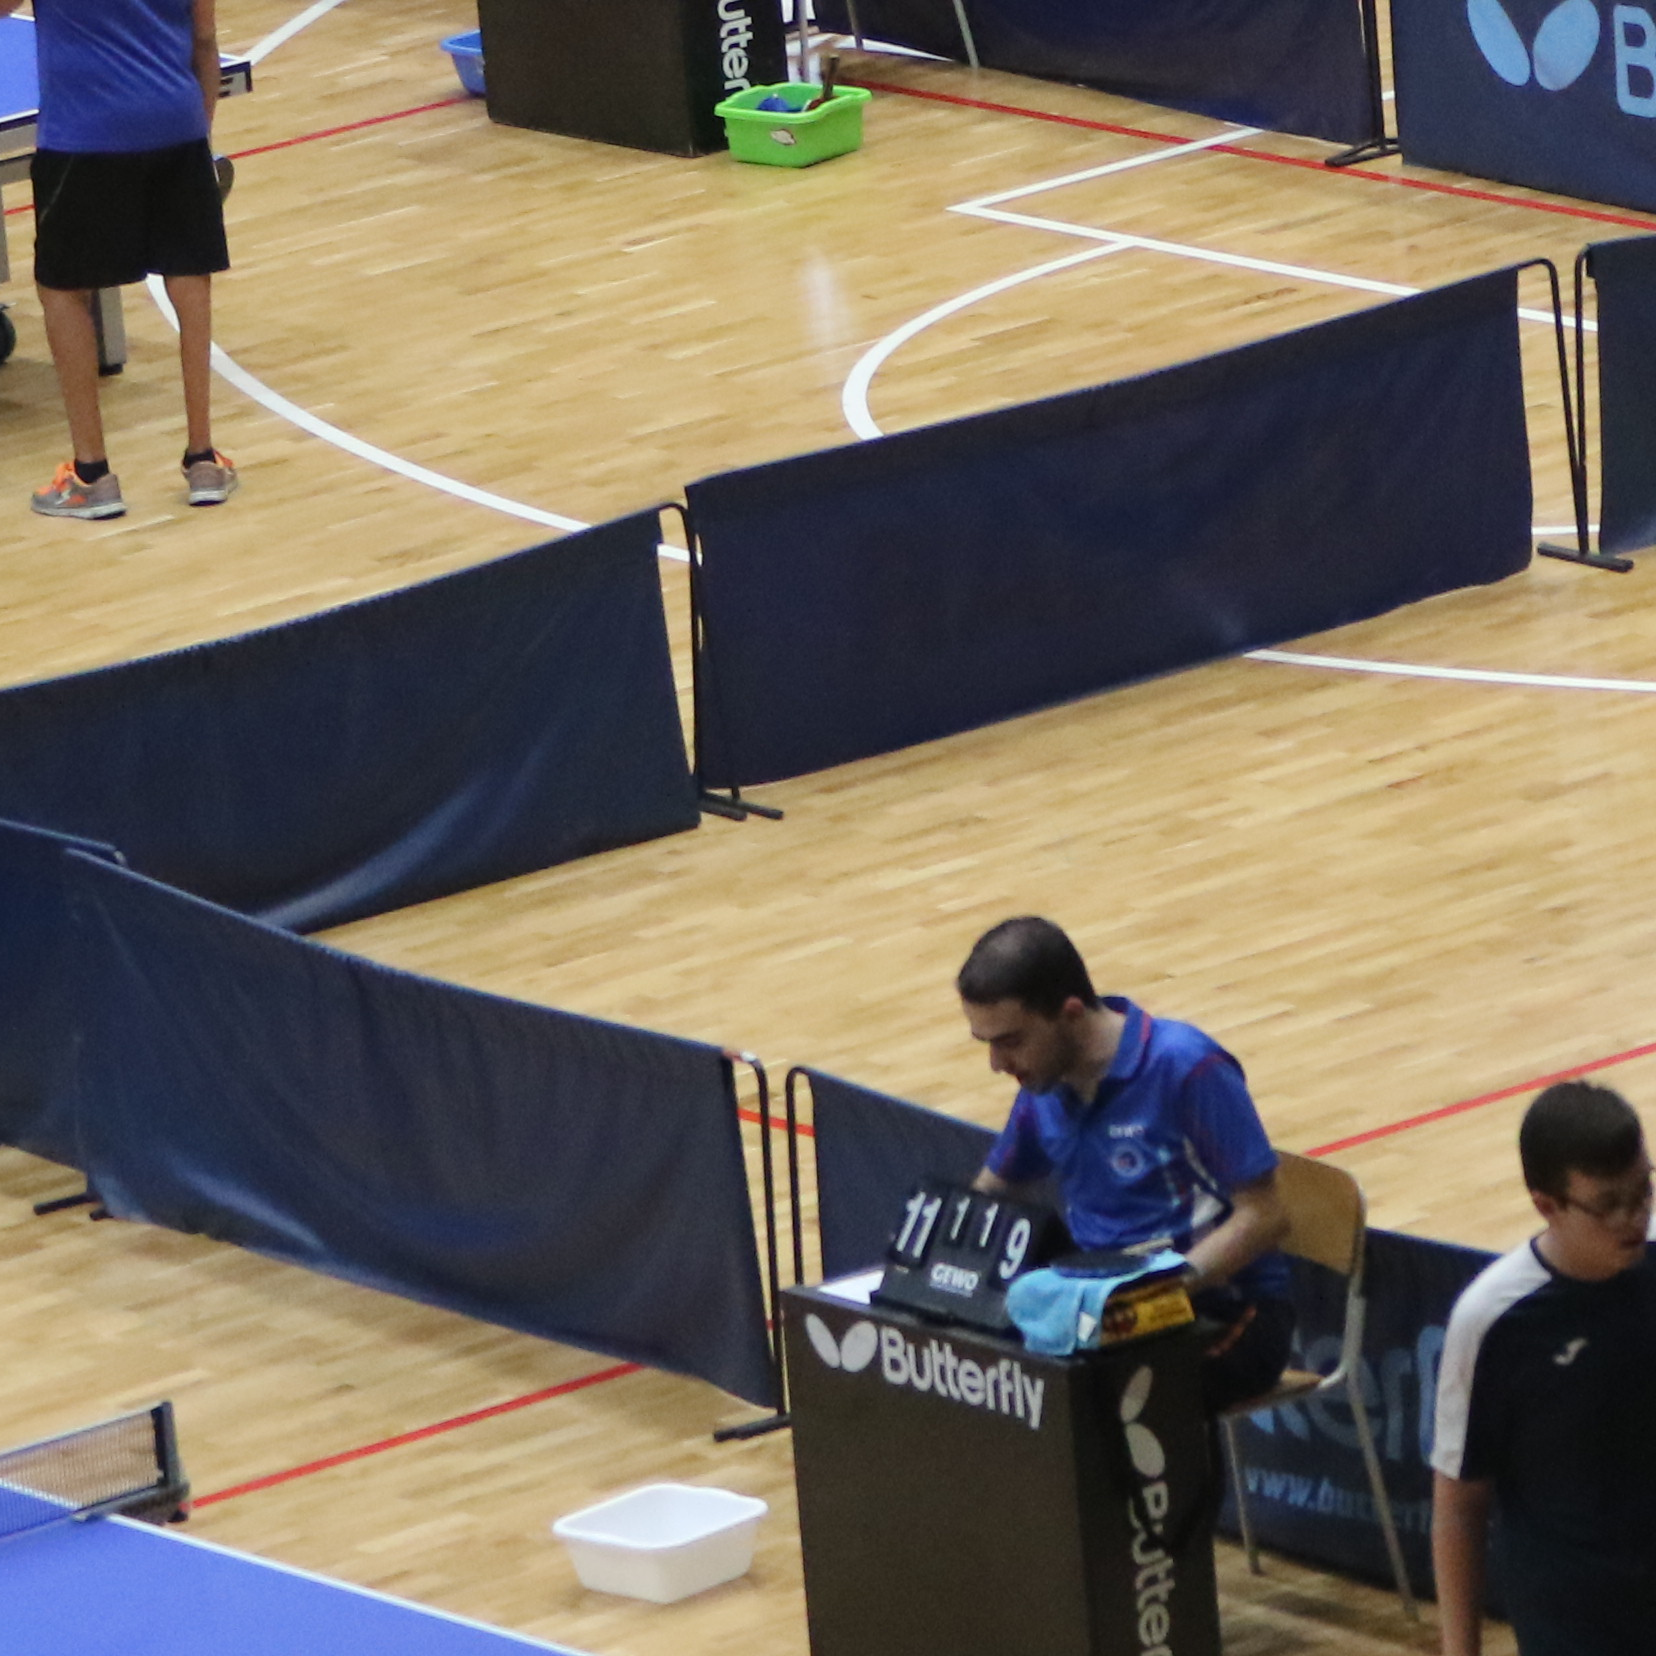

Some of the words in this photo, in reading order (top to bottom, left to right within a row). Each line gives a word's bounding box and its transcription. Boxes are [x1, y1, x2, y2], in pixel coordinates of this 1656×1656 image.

[896, 1192, 942, 1258] 11
[951, 1198, 970, 1239] 1
[979, 1204, 998, 1247] 1
[1000, 1218, 1031, 1281] 9
[930, 1262, 979, 1292] GEWO
[880, 1326, 1046, 1430] Butterfly
